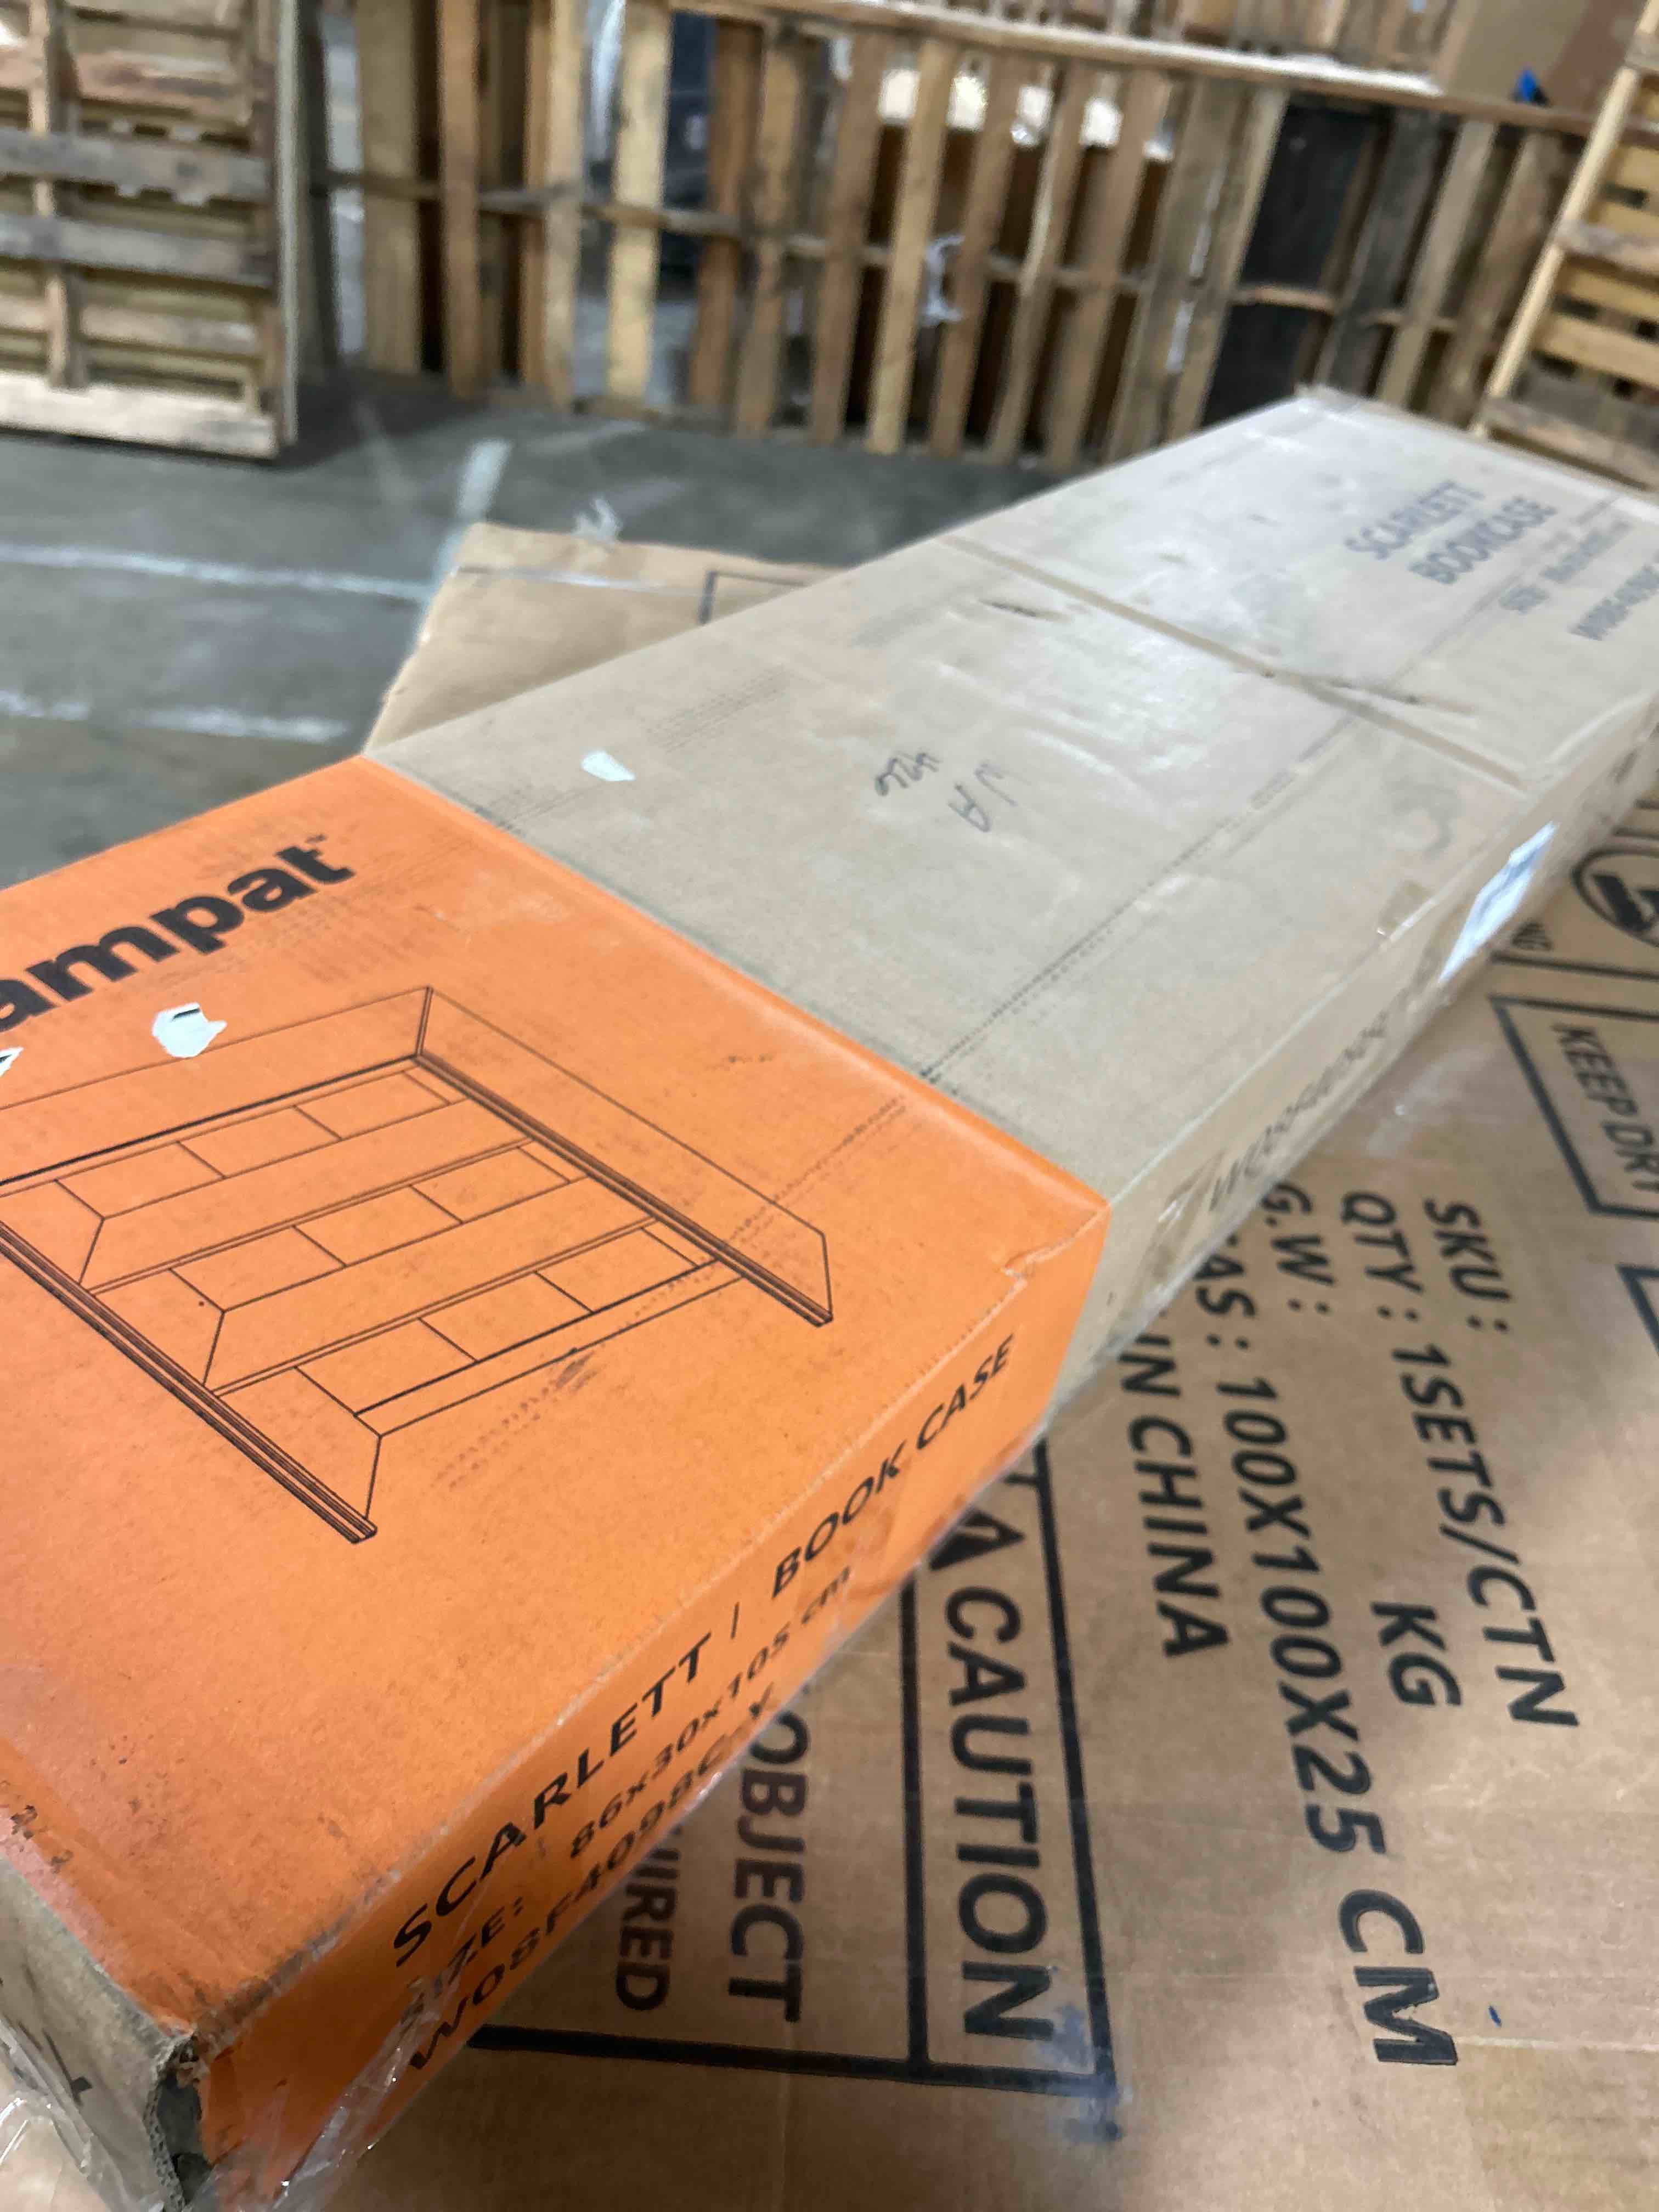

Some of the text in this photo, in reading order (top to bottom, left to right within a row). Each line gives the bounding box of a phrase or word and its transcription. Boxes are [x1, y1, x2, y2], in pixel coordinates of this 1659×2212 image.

[1550, 1023, 1638, 1117] KEEP
[393, 1629, 712, 1967] SCARLETT
[771, 1438, 909, 1599] BOOK
[916, 1333, 1014, 1451] CASE
[1117, 1333, 1230, 1658] IN CHINA
[1371, 1601, 1464, 1707] KG
[1392, 1342, 1579, 1726] 1SETS/CTN
[728, 1708, 811, 2024] OBJECT
[943, 1584, 1056, 2042] CAUTION
[1215, 1376, 1387, 1854] 100X100X25
[1337, 1888, 1459, 2067] CM
